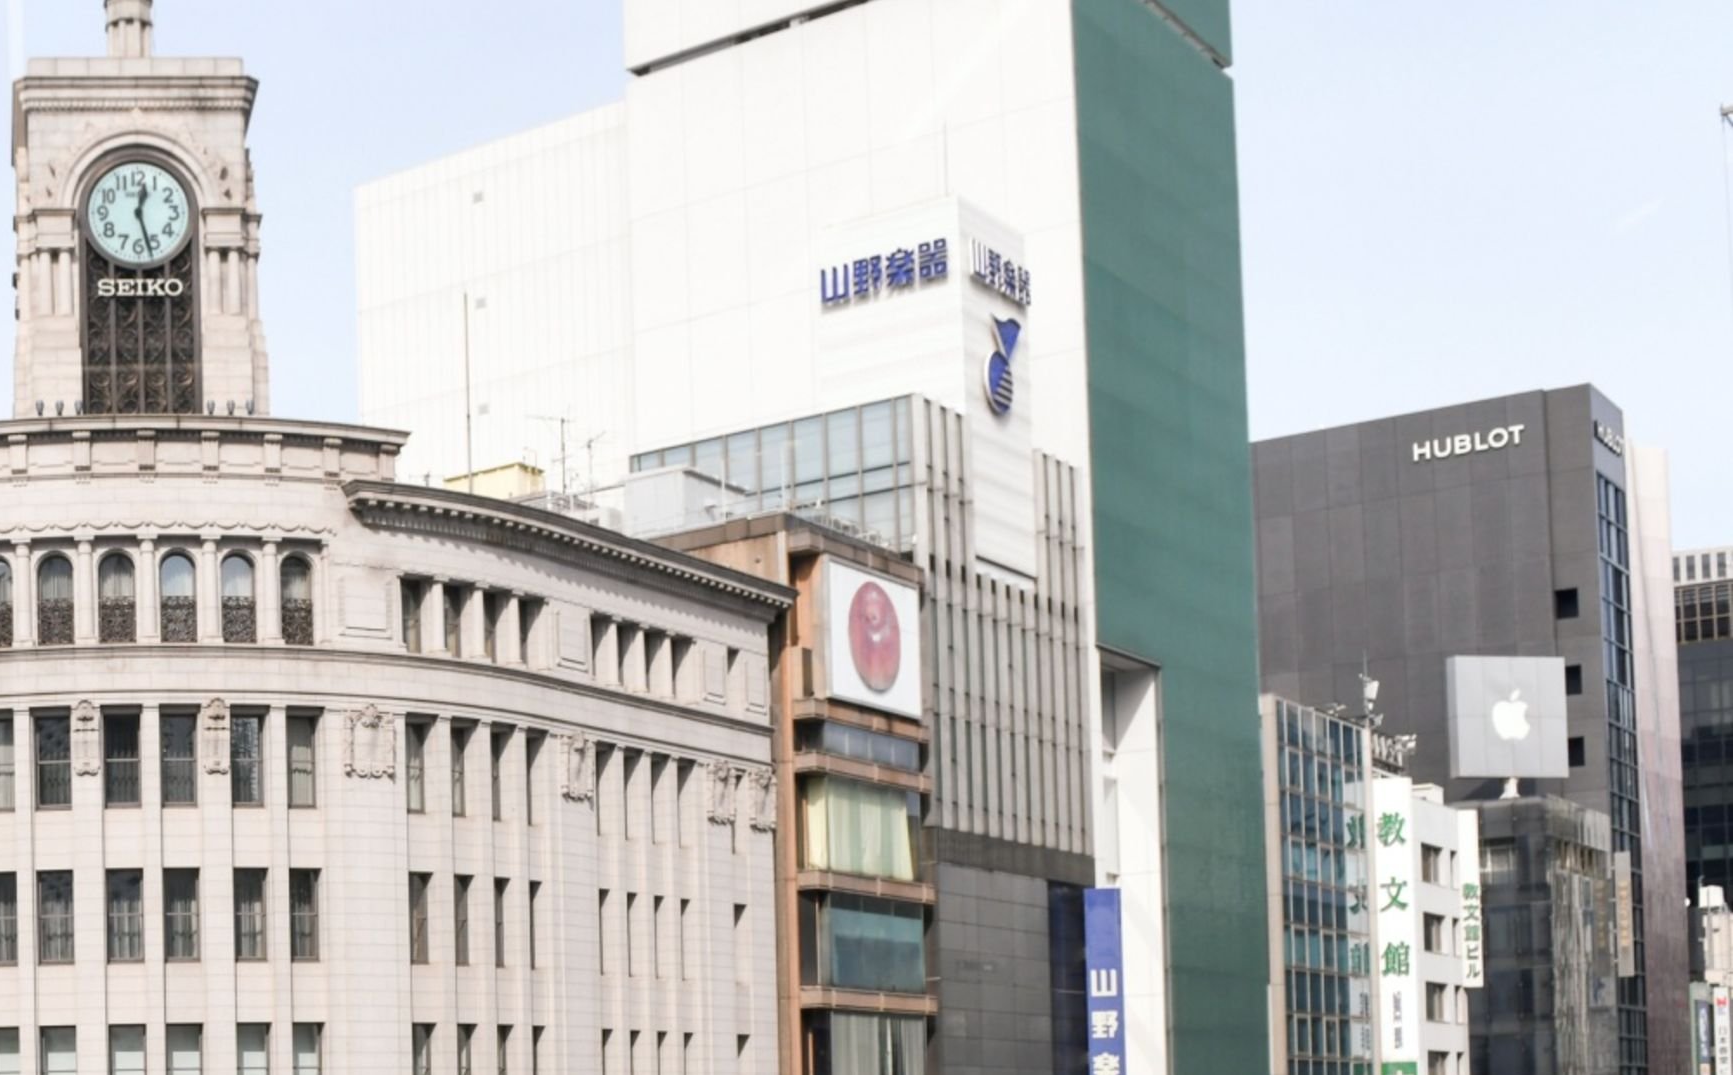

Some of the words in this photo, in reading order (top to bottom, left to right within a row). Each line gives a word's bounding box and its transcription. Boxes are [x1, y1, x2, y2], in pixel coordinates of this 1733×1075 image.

[116, 175, 127, 191] 11
[131, 171, 145, 187] 12
[152, 176, 157, 191] 1
[101, 188, 116, 204] 10
[163, 187, 174, 203] 2
[97, 205, 109, 221] 9
[168, 205, 180, 221] 3
[103, 222, 115, 238] 8
[162, 222, 174, 237] 4
[117, 234, 129, 250] 7
[132, 238, 145, 254] 6
[149, 234, 160, 250] 5
[820, 238, 948, 304] 山野楽器
[97, 278, 184, 297] SEIKO
[1412, 424, 1525, 462] HUBLOT
[1376, 811, 1410, 977] 教文館
[1462, 883, 1481, 979] 教文館ビル
